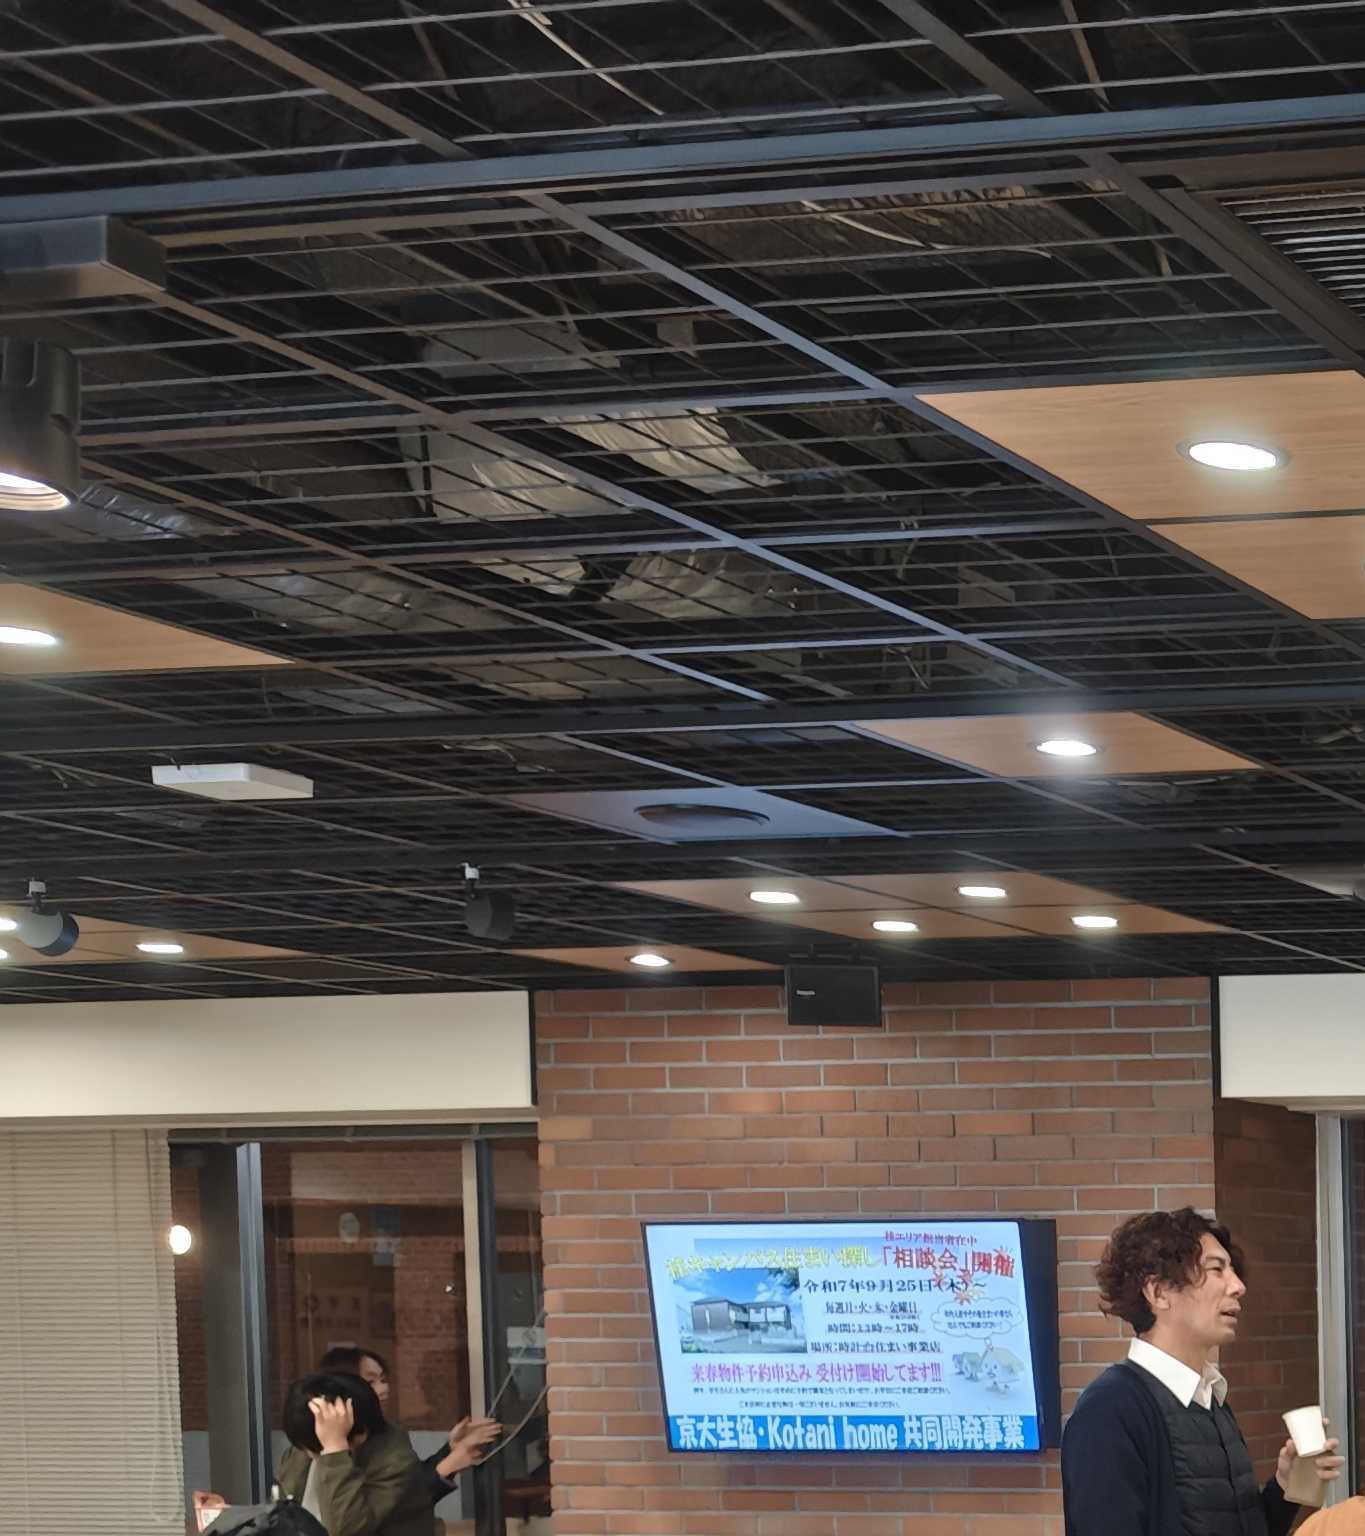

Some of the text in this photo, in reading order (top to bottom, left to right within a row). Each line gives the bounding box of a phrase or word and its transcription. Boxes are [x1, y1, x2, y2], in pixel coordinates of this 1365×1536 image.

[844, 1416, 898, 1449] home
[904, 1415, 1024, 1449] 共同開発事業
